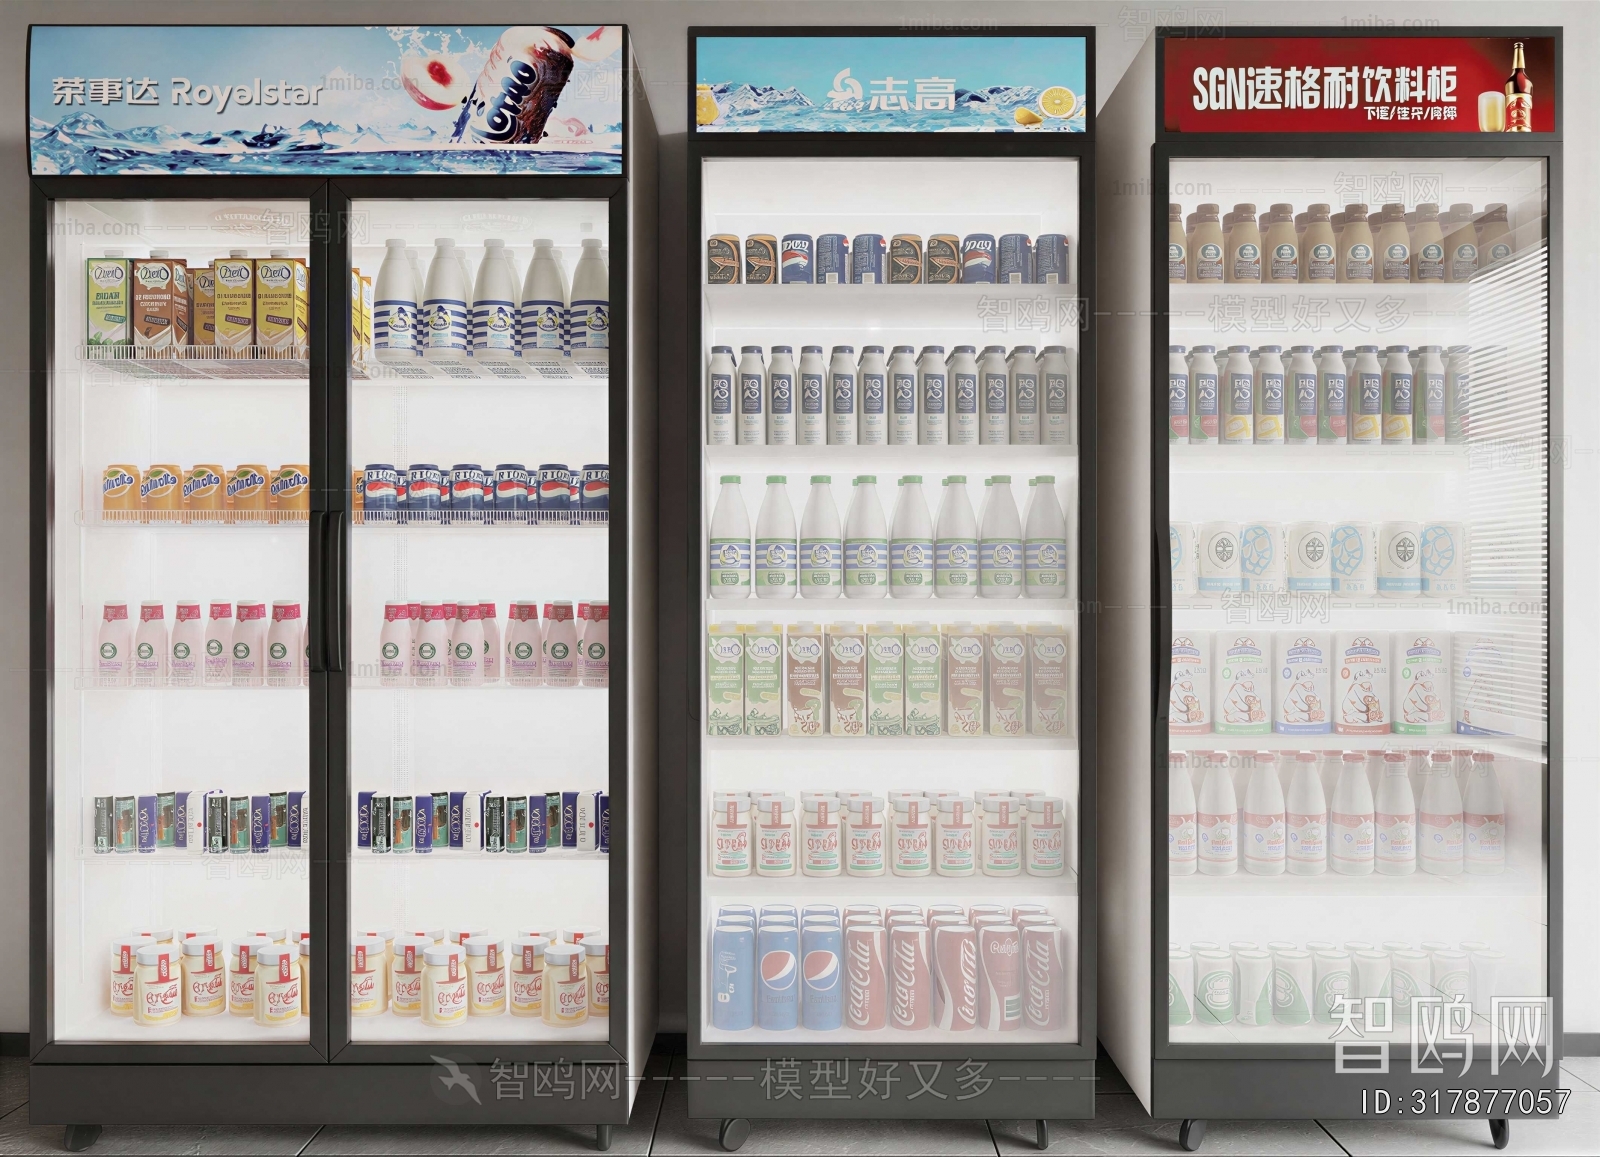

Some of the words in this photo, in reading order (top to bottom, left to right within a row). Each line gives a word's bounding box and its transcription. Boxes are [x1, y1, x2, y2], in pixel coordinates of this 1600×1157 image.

[52, 76, 159, 106] 荣事达
[171, 76, 322, 114] Royalstar
[869, 76, 956, 111] 志高
